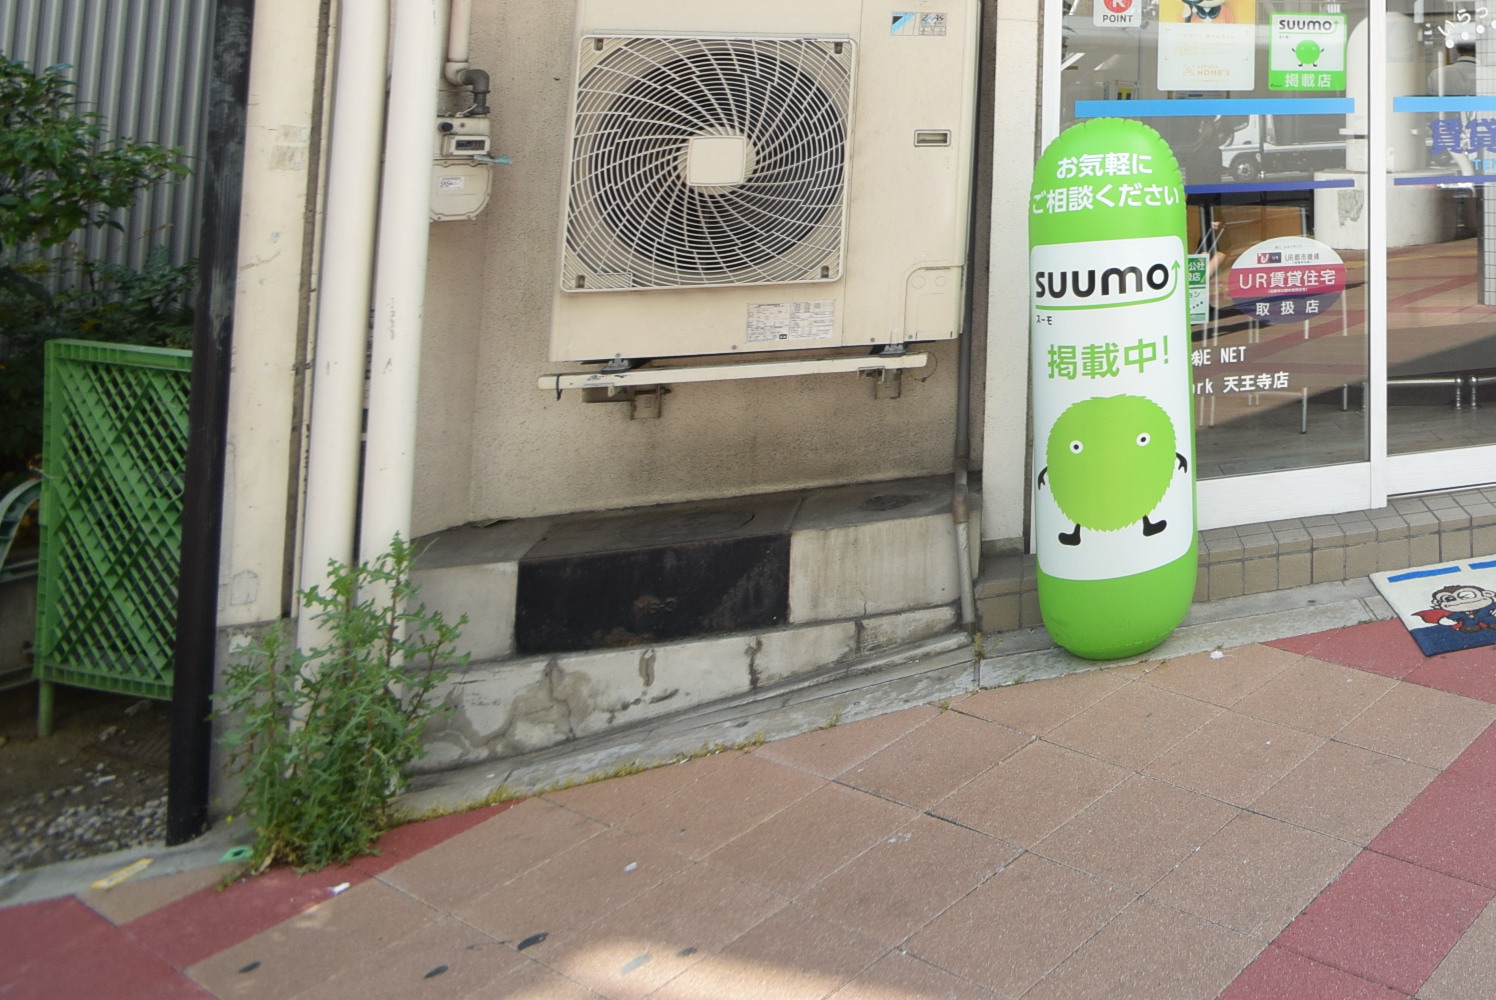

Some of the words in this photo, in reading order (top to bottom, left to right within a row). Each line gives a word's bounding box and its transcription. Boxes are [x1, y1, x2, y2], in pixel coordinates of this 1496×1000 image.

[1102, 14, 1133, 23] POINT
[1284, 73, 1332, 88] 掲載店
[1056, 152, 1153, 179] お気軽に
[1032, 185, 1179, 215] ご相談ください
[1240, 269, 1336, 290] UR賃貸住宅
[1255, 299, 1319, 317] 取扱店
[1036, 314, 1053, 326] スーモ
[1220, 346, 1247, 364] NET
[1192, 378, 1214, 395] rk
[1222, 371, 1290, 393] 天王寺店
